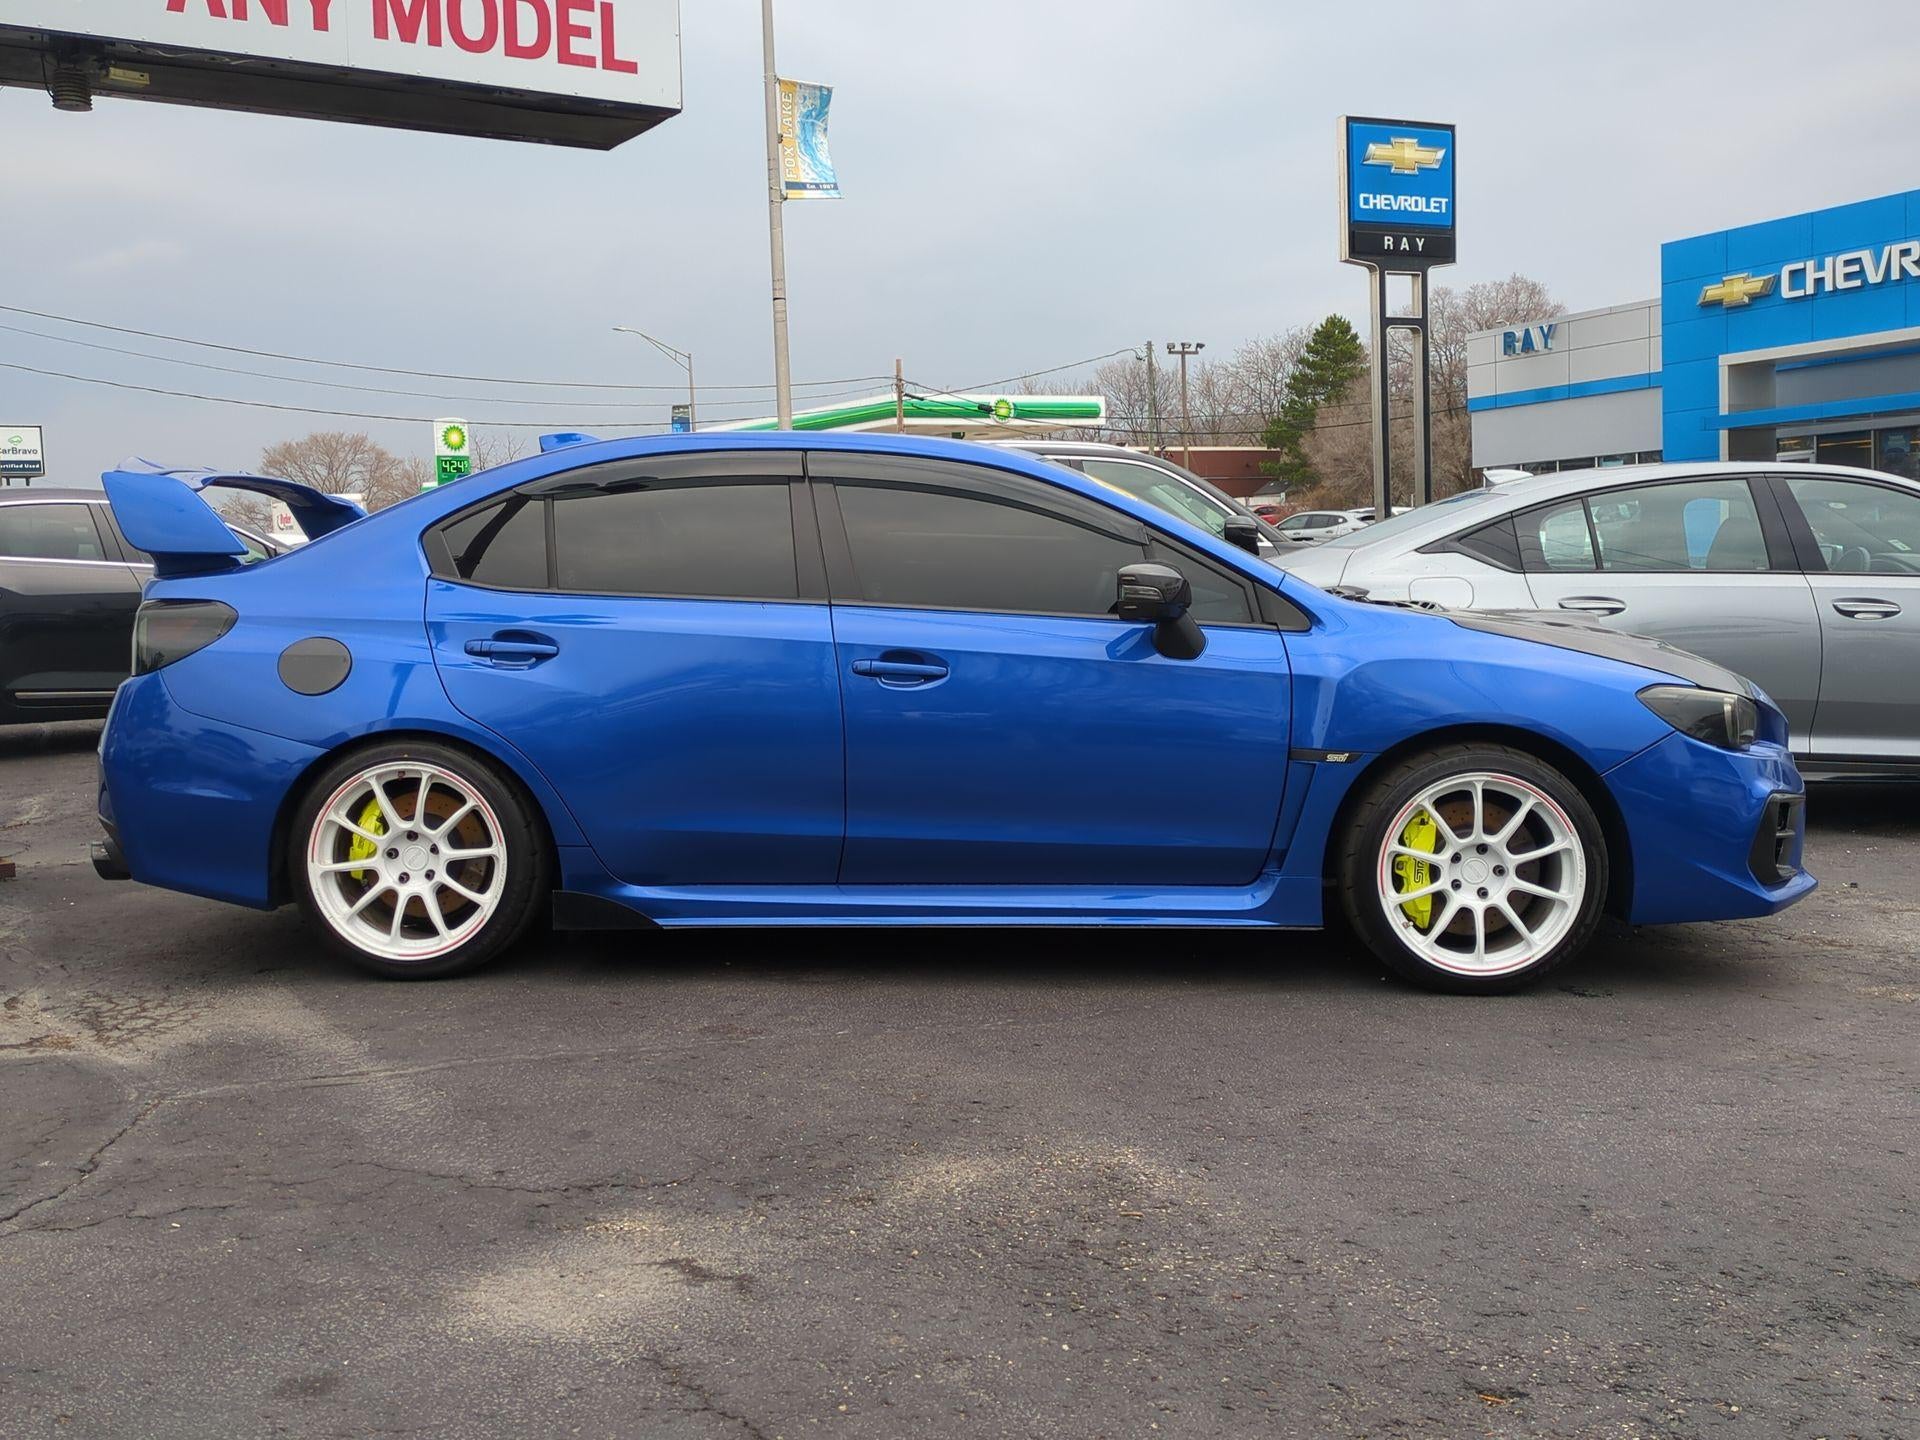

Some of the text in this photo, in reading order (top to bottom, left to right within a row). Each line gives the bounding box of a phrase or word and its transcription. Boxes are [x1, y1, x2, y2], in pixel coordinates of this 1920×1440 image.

[373, 0, 638, 75] MODEL
[781, 92, 797, 179] FOX LAKE
[1359, 193, 1449, 213] CHEVROLET
[1384, 236, 1425, 252] RAY
[1781, 240, 1920, 299] CHEVR
[1502, 323, 1556, 356] RAY
